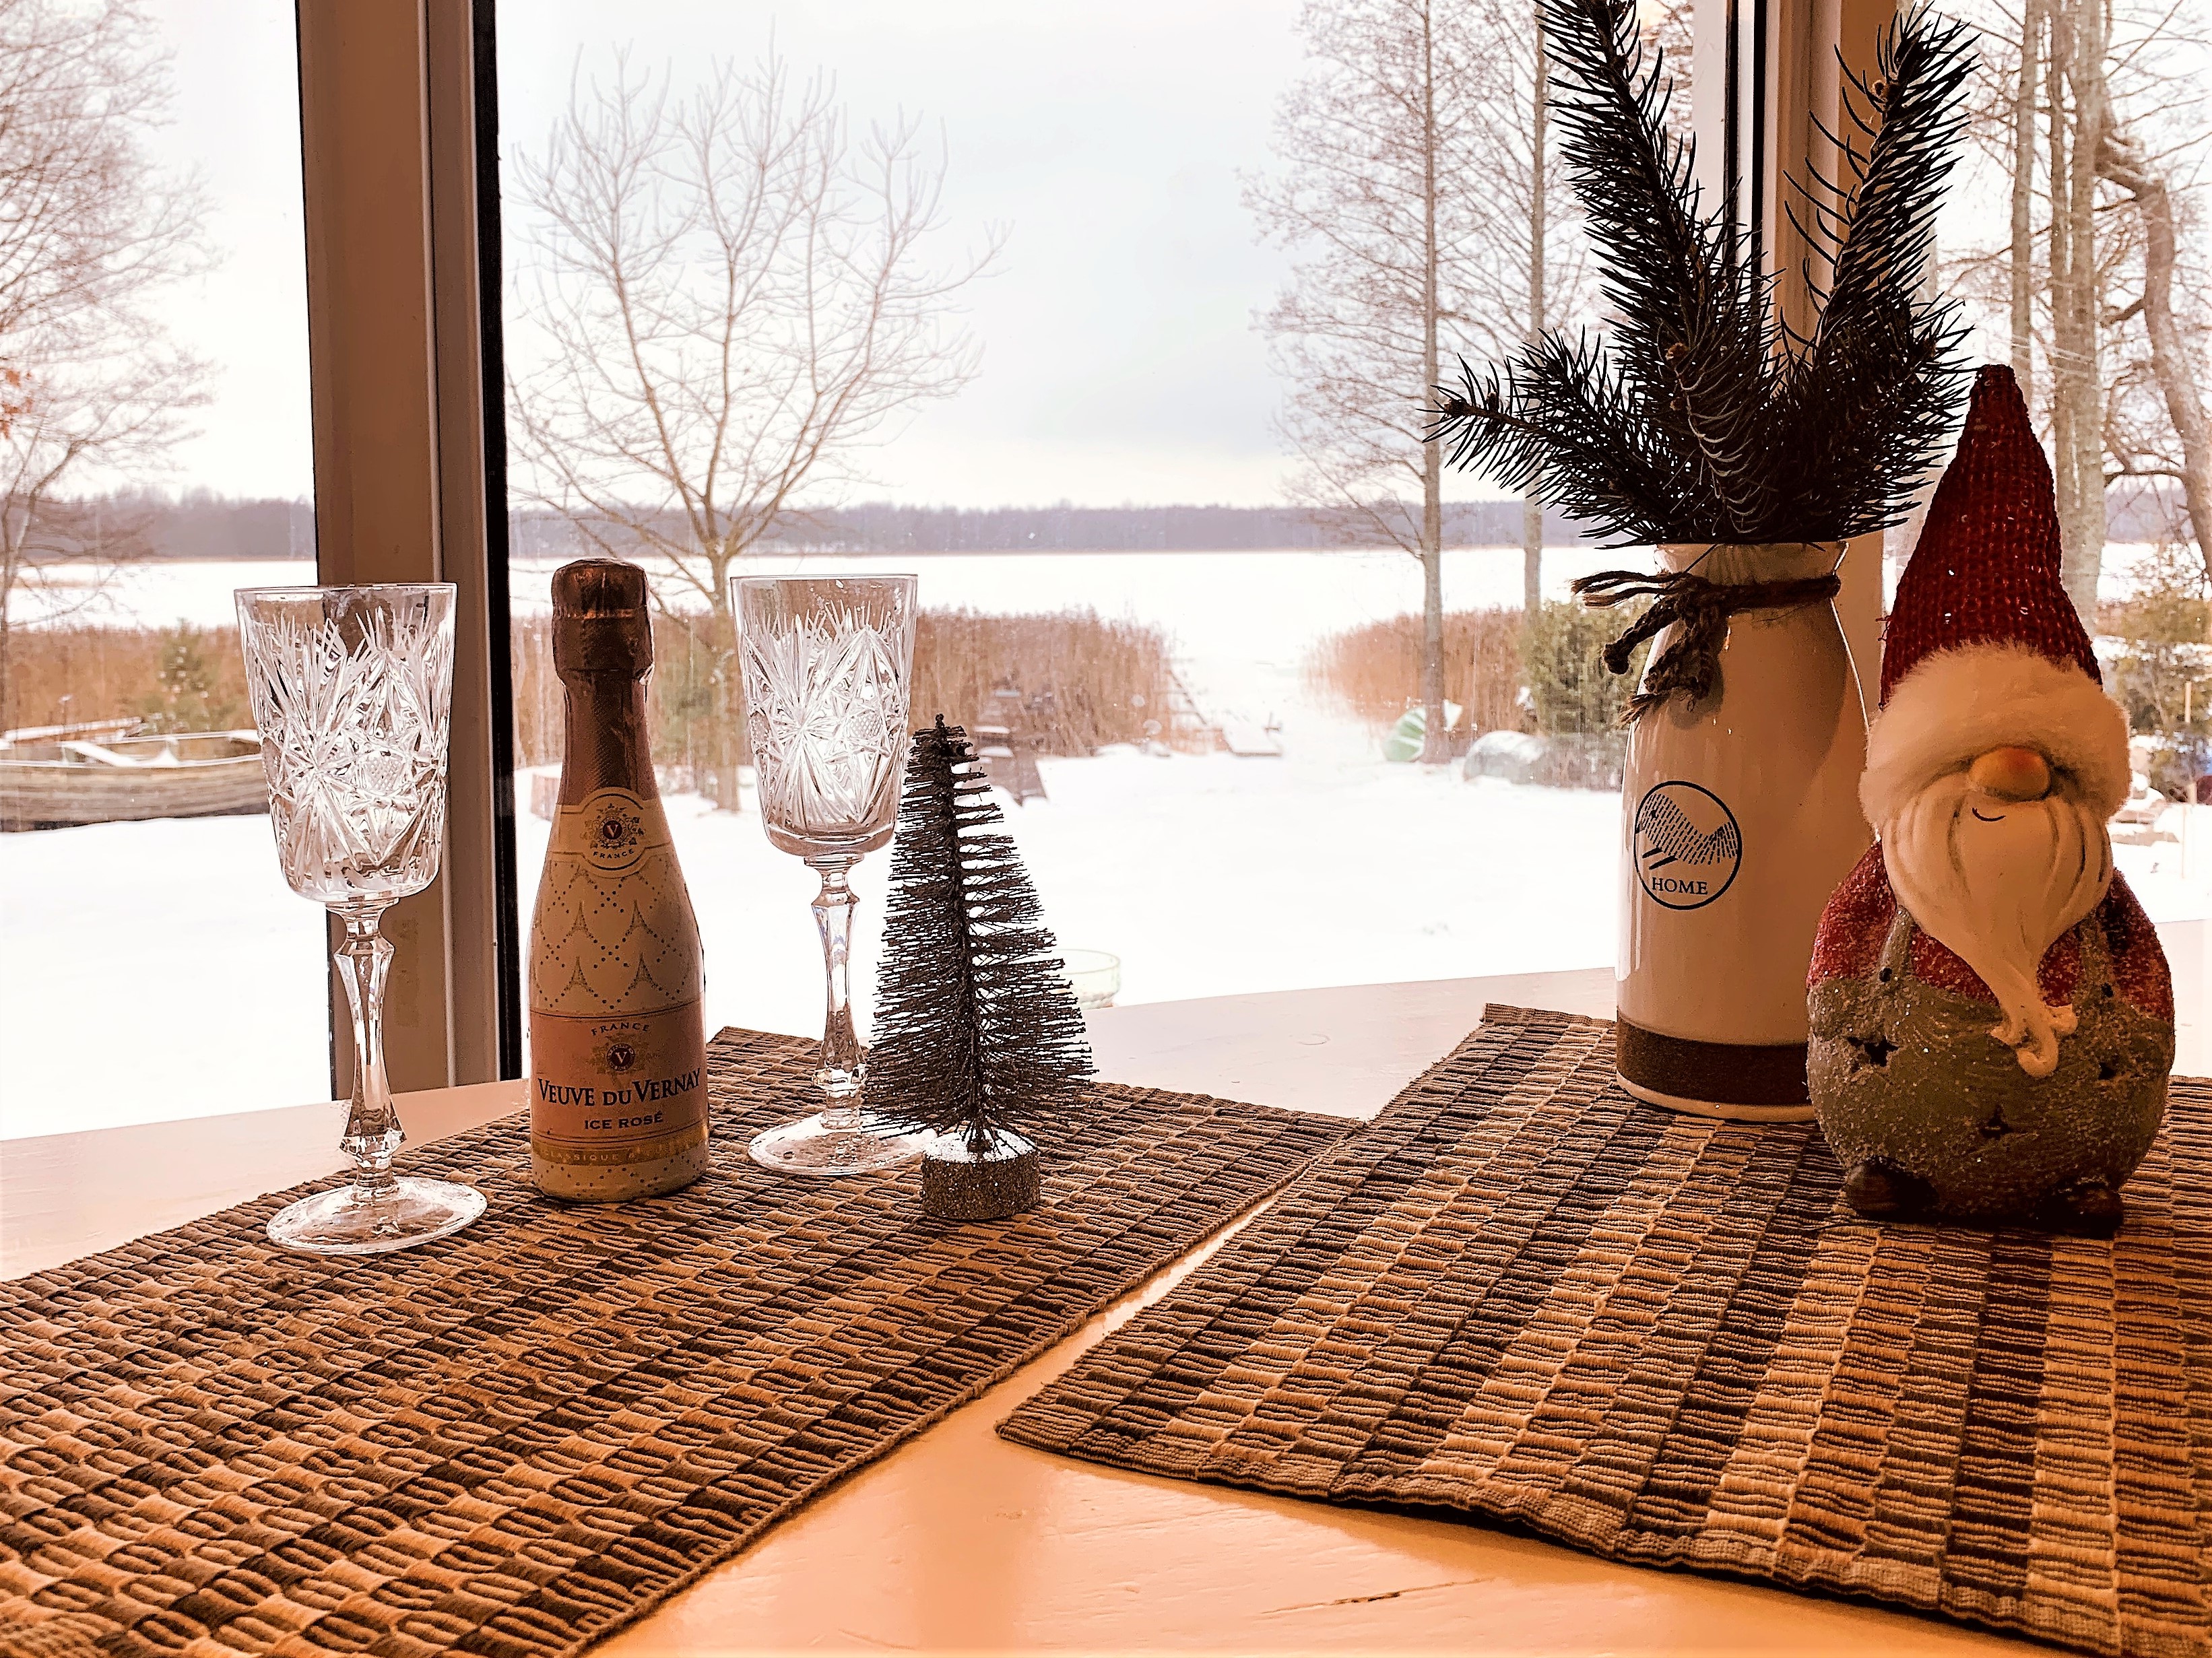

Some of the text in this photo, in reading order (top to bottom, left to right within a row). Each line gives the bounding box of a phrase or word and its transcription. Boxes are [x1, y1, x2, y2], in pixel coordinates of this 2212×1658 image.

[607, 824, 619, 838] V
[593, 849, 635, 859] FRANCE
[1652, 877, 1708, 895] HOME
[591, 1022, 650, 1036] FRANCE
[615, 1051, 628, 1063] V
[538, 1077, 595, 1106] VEUVE
[632, 1067, 701, 1102] VERNAY
[584, 1111, 663, 1130] ICE ROSÉ
